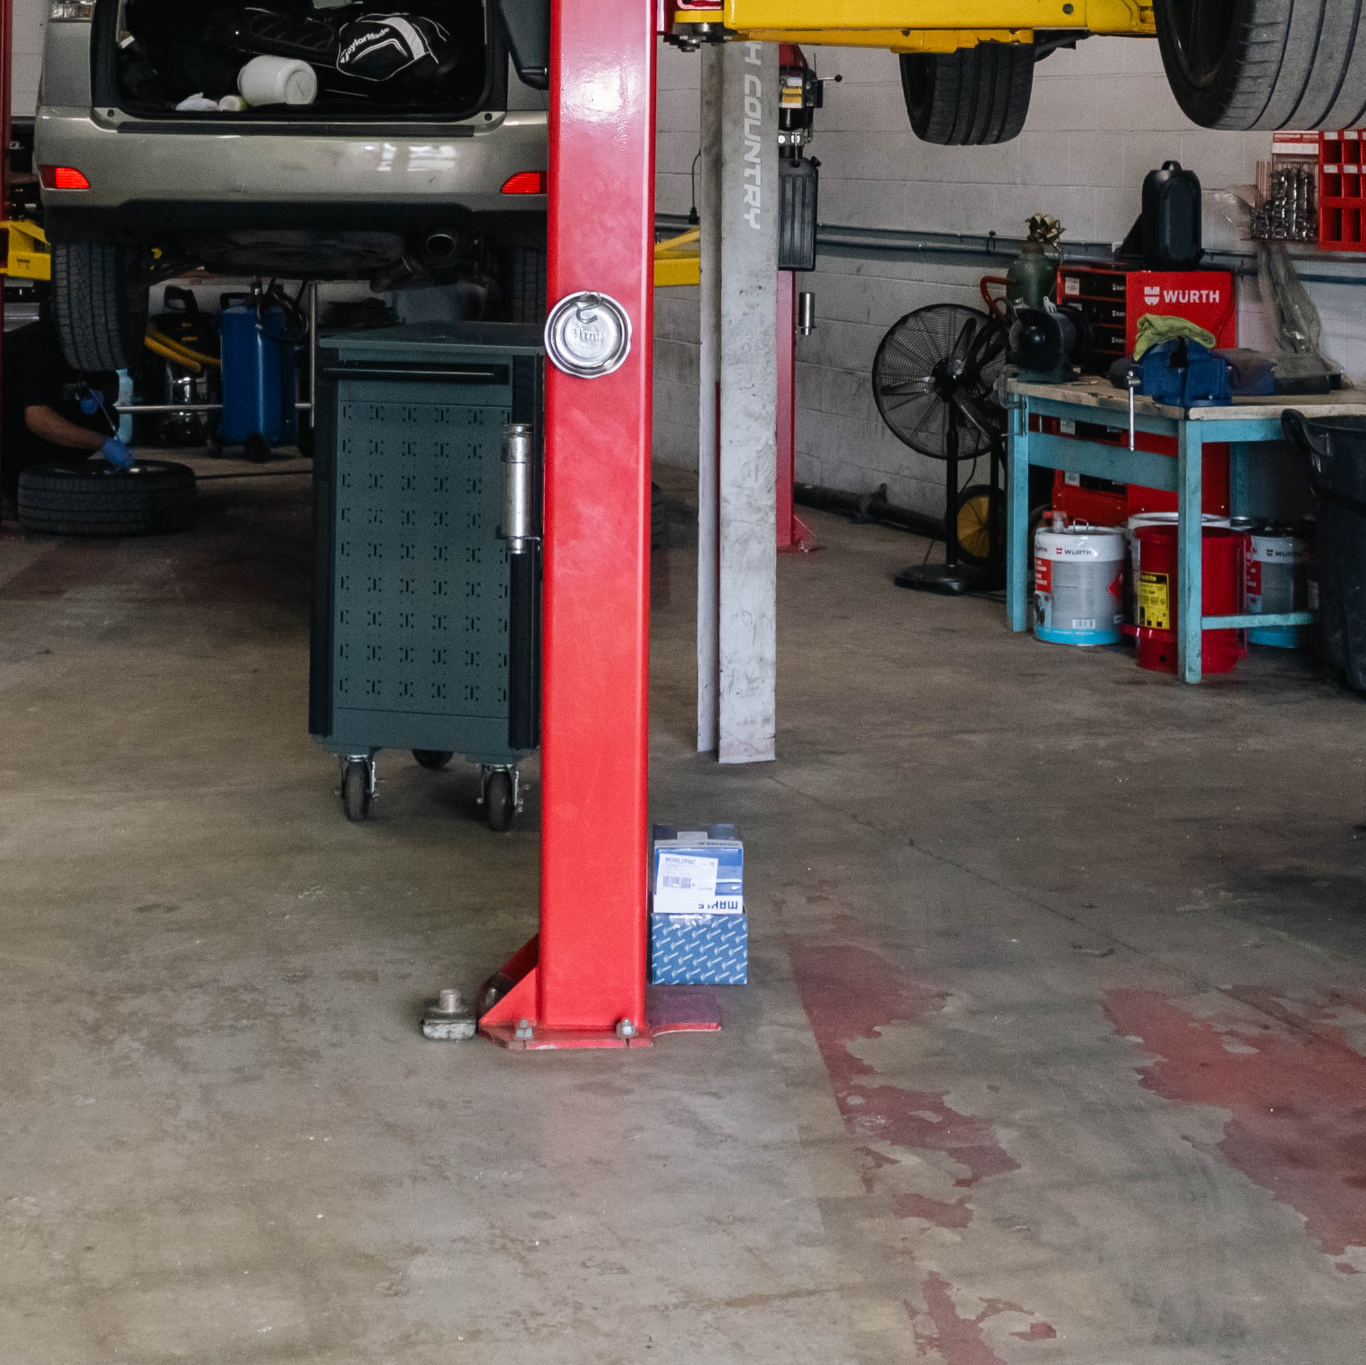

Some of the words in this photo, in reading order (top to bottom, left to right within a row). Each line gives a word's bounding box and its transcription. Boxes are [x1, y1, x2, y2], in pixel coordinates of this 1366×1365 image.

[339, 26, 391, 64] TaylorMade
[743, 73, 763, 231] COUNTRY
[1163, 289, 1220, 304] WÜRTH
